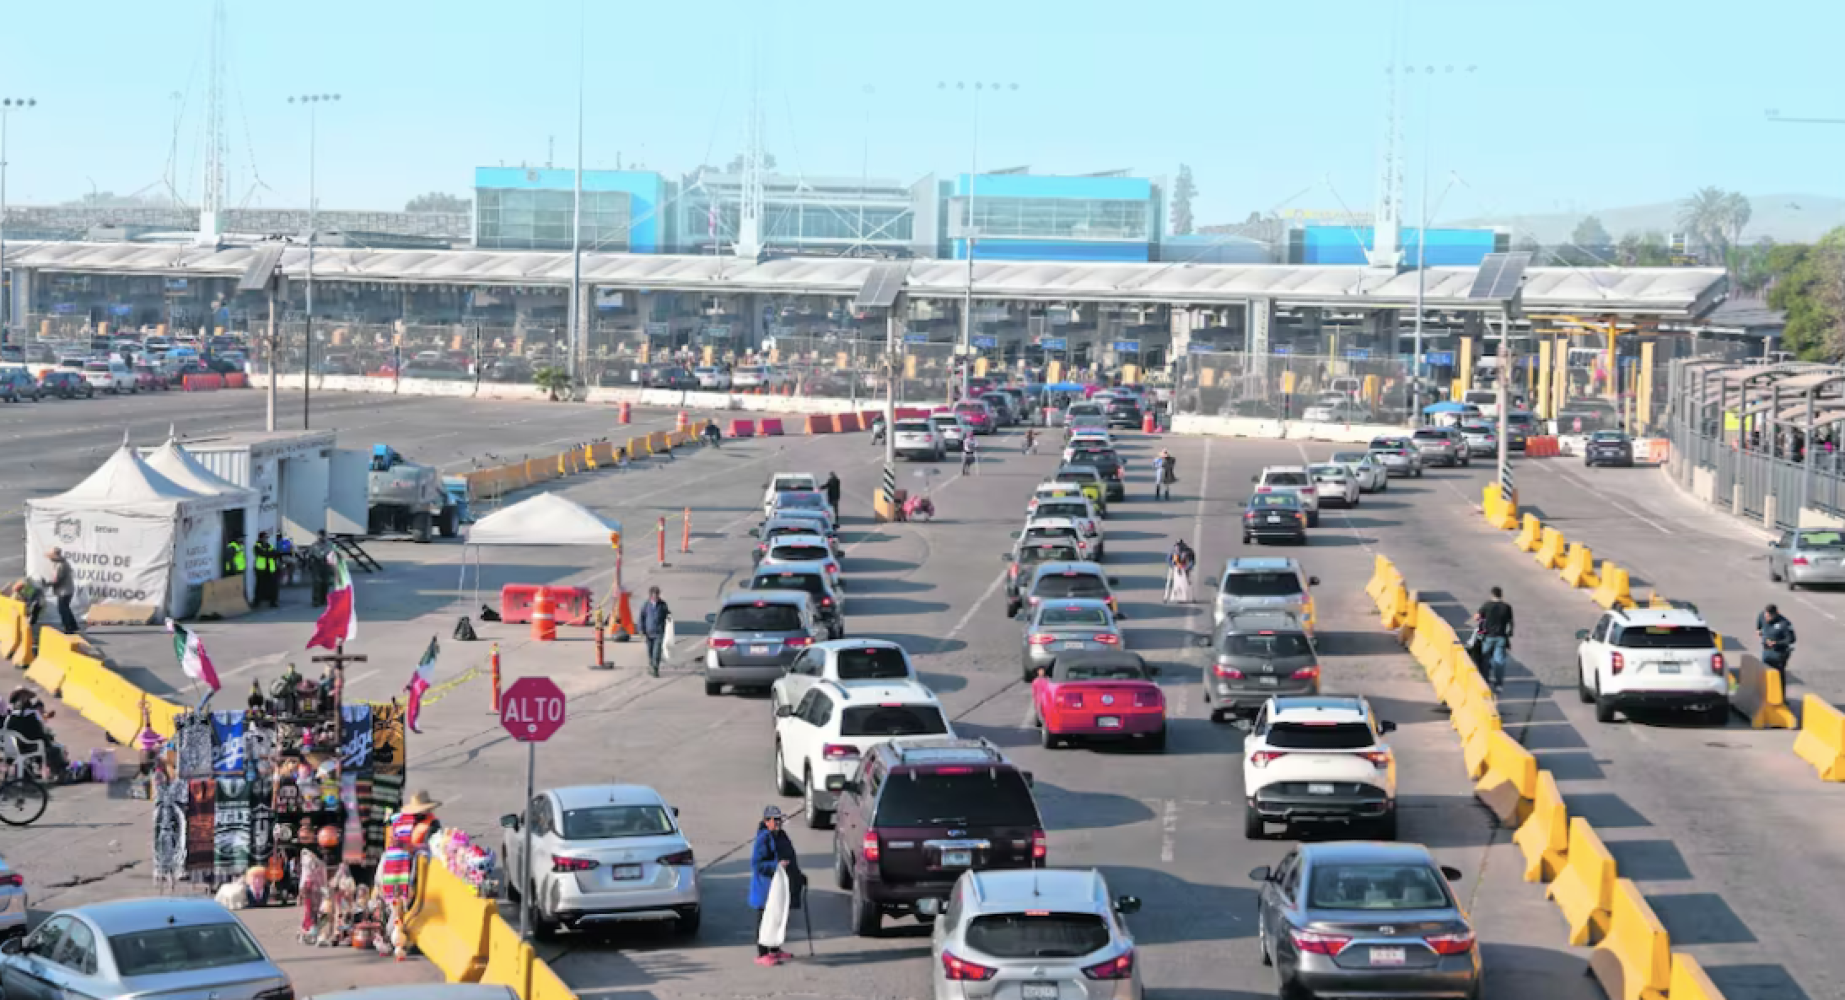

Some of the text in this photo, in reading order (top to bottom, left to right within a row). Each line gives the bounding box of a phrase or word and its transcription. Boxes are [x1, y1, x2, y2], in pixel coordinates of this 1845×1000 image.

[64, 551, 131, 567] PUNTO DE
[73, 569, 123, 583] UXILIO
[504, 697, 562, 722] ALTO
